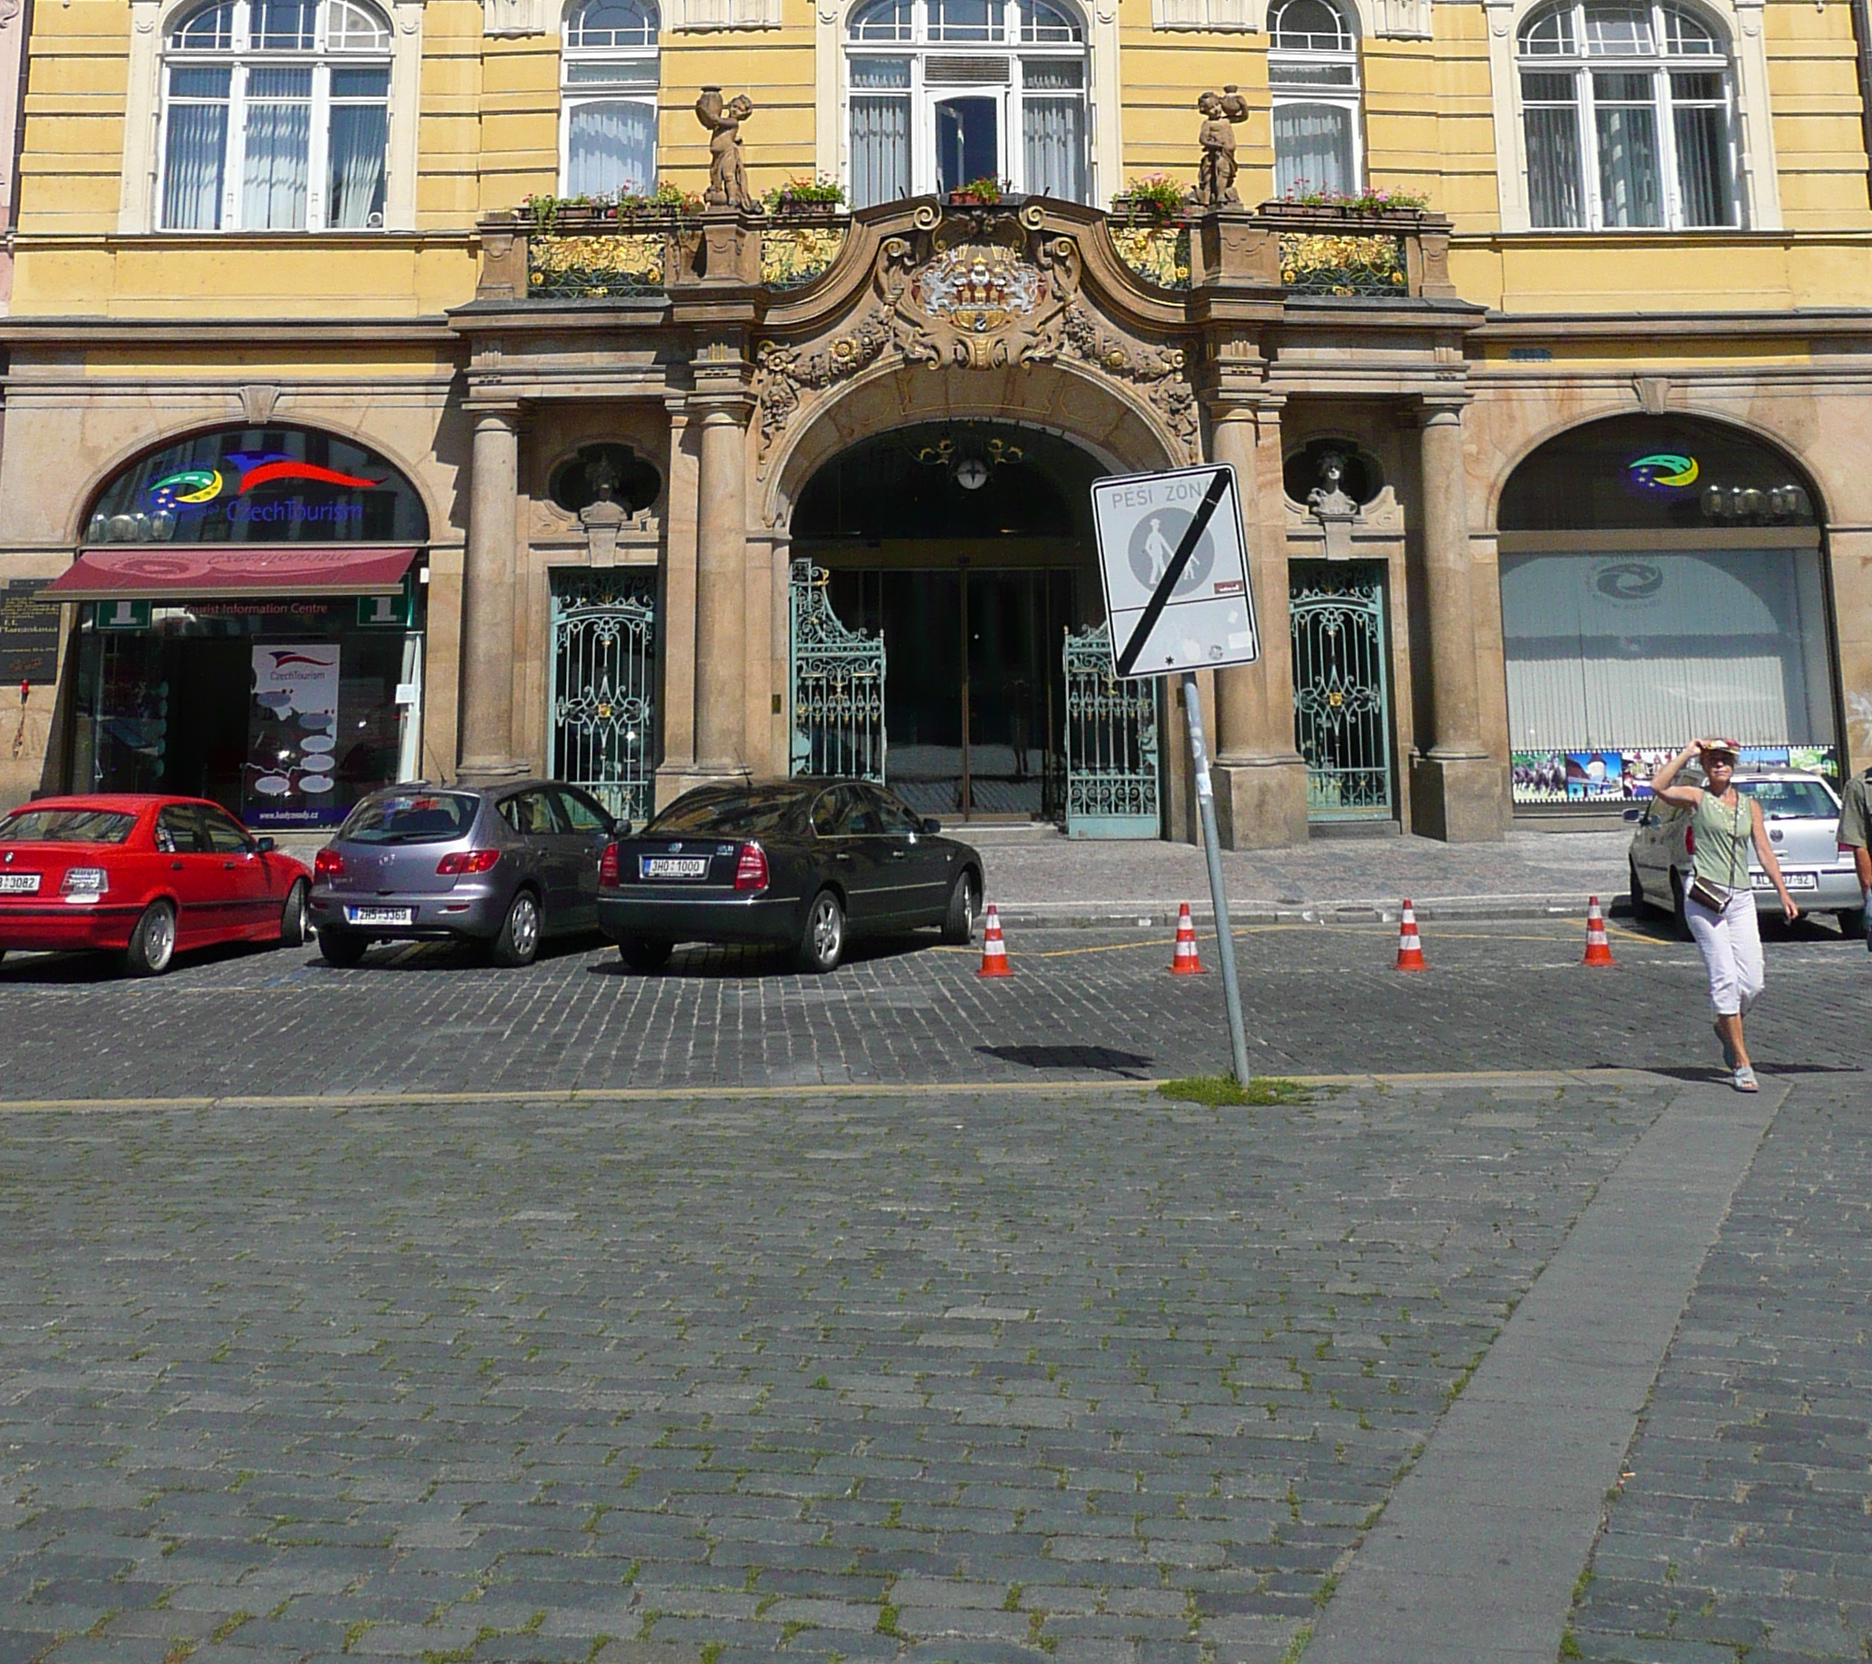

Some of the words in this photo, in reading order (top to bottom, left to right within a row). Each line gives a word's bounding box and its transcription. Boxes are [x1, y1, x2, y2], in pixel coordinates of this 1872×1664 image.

[1165, 479, 1211, 502] ZÓN
[226, 500, 363, 522] CzechTourism
[184, 603, 220, 614] Tourist
[222, 603, 288, 614] Information
[291, 603, 328, 614] Centre
[270, 670, 326, 681] CzechTourism
[676, 861, 700, 872] 1000
